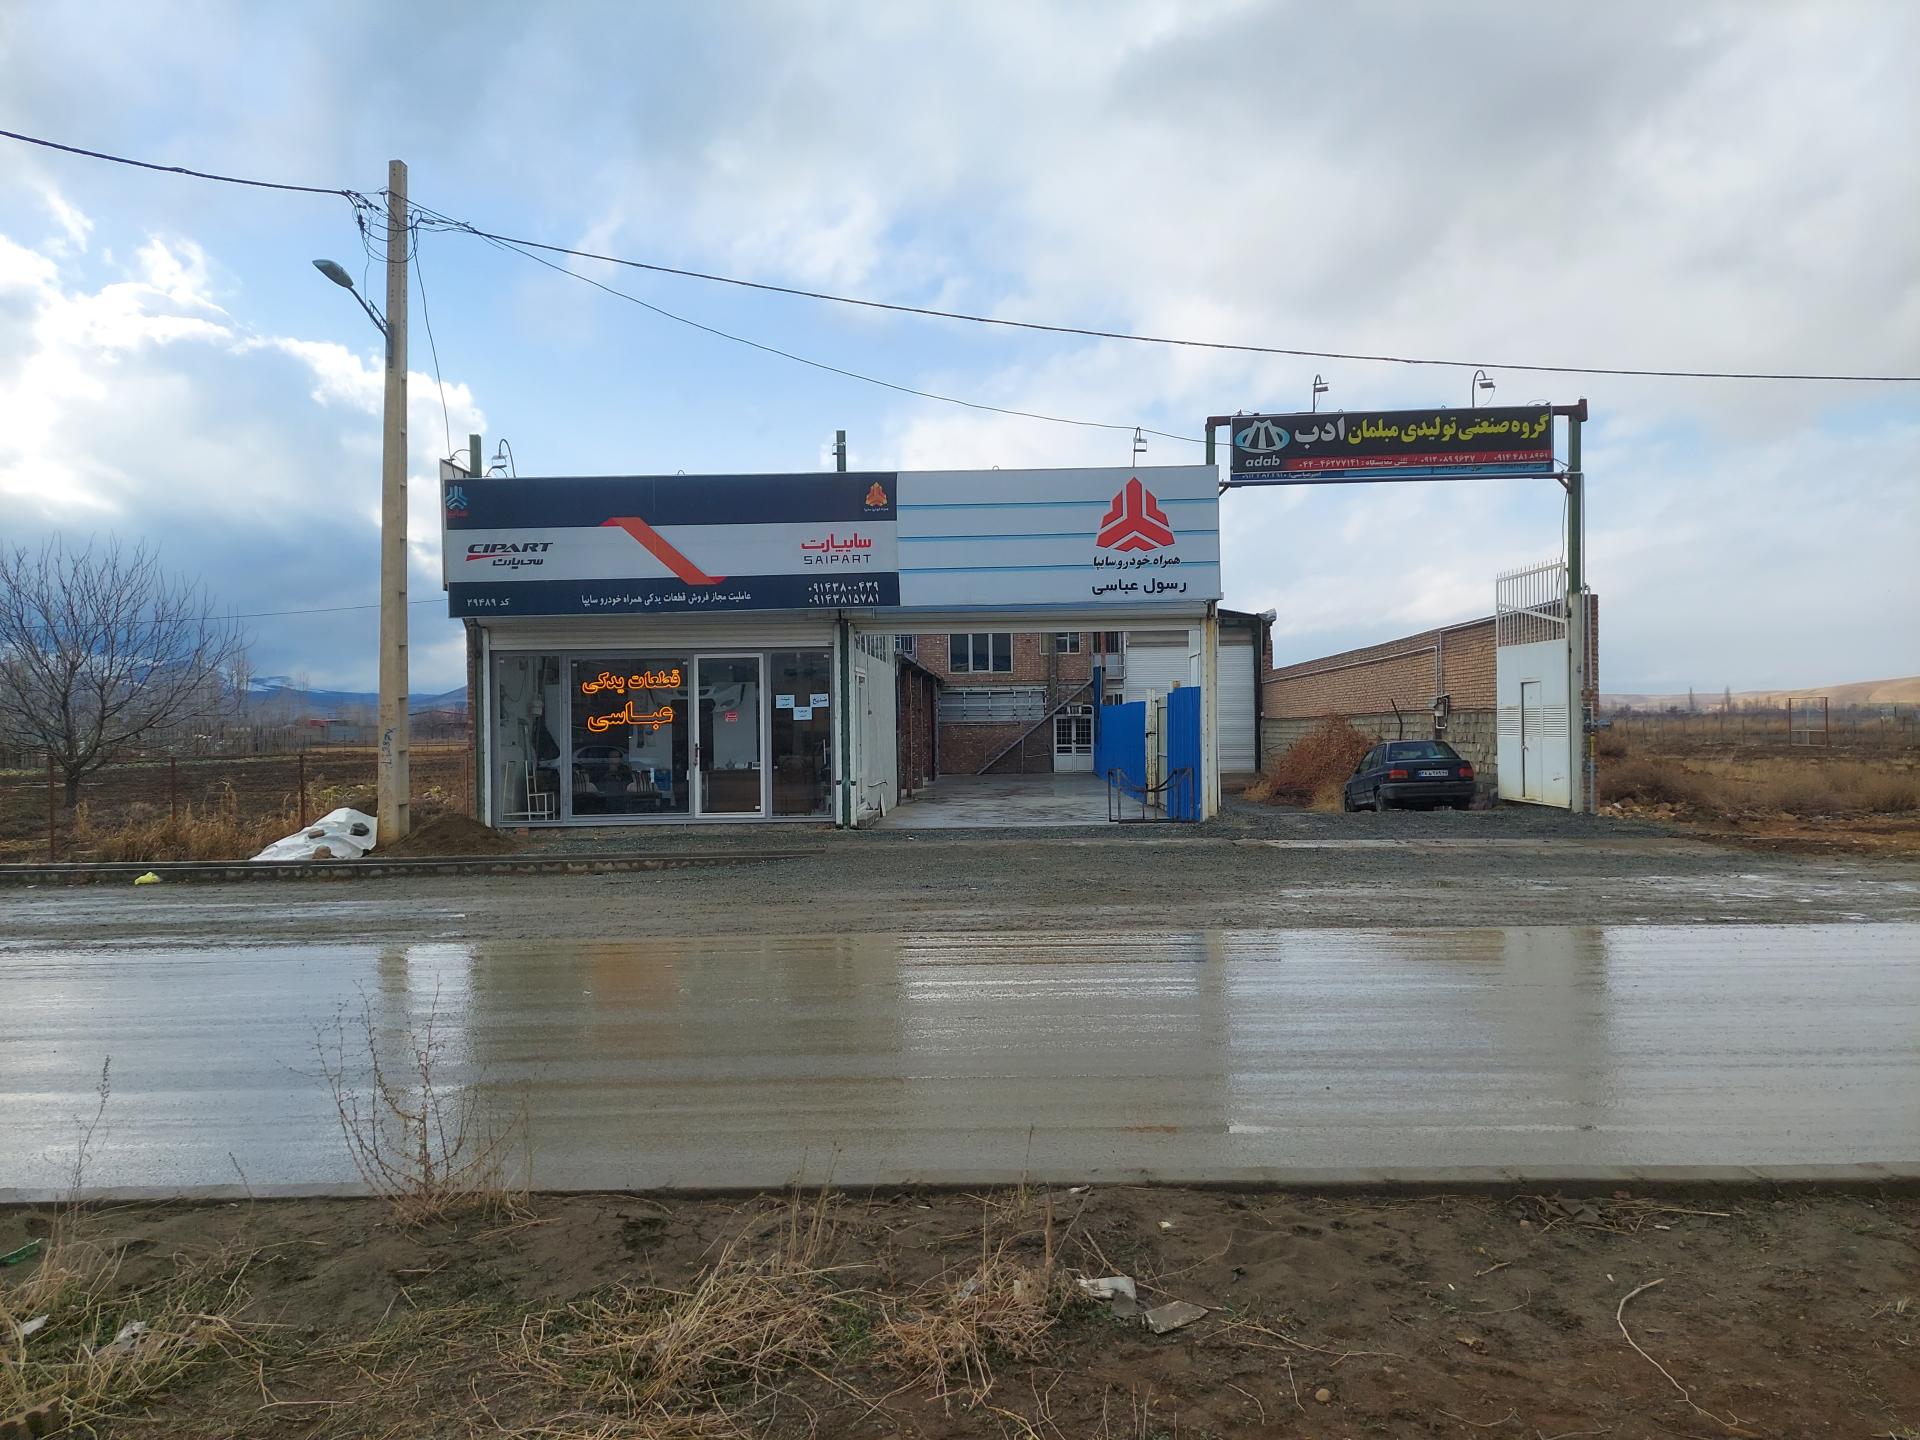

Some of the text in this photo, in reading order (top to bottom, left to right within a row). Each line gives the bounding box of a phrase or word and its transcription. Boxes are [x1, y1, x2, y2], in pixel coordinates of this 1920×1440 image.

[1294, 413, 1549, 449] گروه صنعتی تولیدی مبلمان ادب
[1245, 455, 1281, 468] adab
[467, 542, 554, 554] CIPART
[801, 532, 872, 553] سایپارت
[804, 554, 872, 565] SAIPART
[1093, 554, 1181, 570] همراه خودرو سایپا
[1092, 577, 1187, 595] رسول عباسی
[500, 598, 511, 606] کد
[581, 591, 752, 607] عاملیت مجاز فروش قطعات یدکی همراه خودرو سایپا
[582, 669, 681, 694] قطعات یدکی
[587, 701, 674, 732] عباسی
